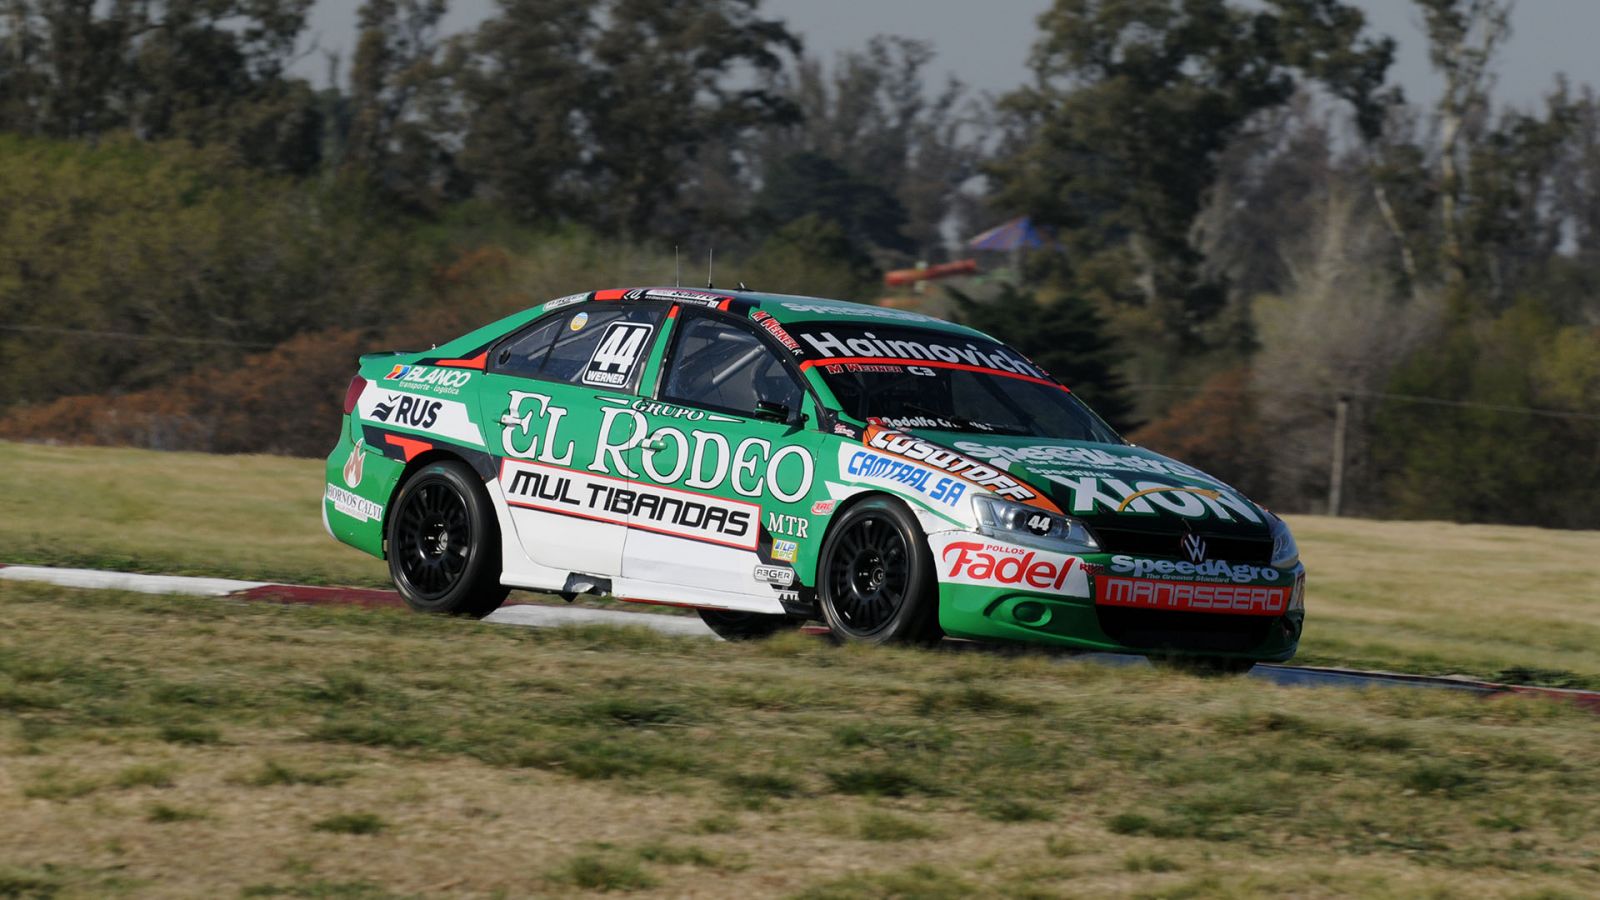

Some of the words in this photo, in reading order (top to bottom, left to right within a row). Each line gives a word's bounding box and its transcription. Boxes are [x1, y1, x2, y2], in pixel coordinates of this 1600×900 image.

[593, 326, 648, 374] 44
[801, 331, 1044, 379] Haimovich
[399, 380, 431, 391] transporte
[404, 365, 472, 388] BLANCO
[586, 370, 626, 385] WERNER
[907, 366, 937, 377] C3
[394, 395, 443, 429] RUS
[631, 399, 706, 421] GRUPO
[501, 389, 576, 467] EL
[587, 406, 815, 503] RODEO
[847, 451, 934, 493] CAMTRAL
[929, 477, 967, 507] SA
[508, 469, 752, 537] MULTIBANDAS
[767, 511, 809, 539] MTR
[1028, 515, 1051, 531] 44
[986, 544, 1025, 555] POLLOS
[942, 541, 1076, 590] Fadel
[1110, 554, 1280, 583] SpeedAgro
[1105, 578, 1284, 611] MANASSERO
